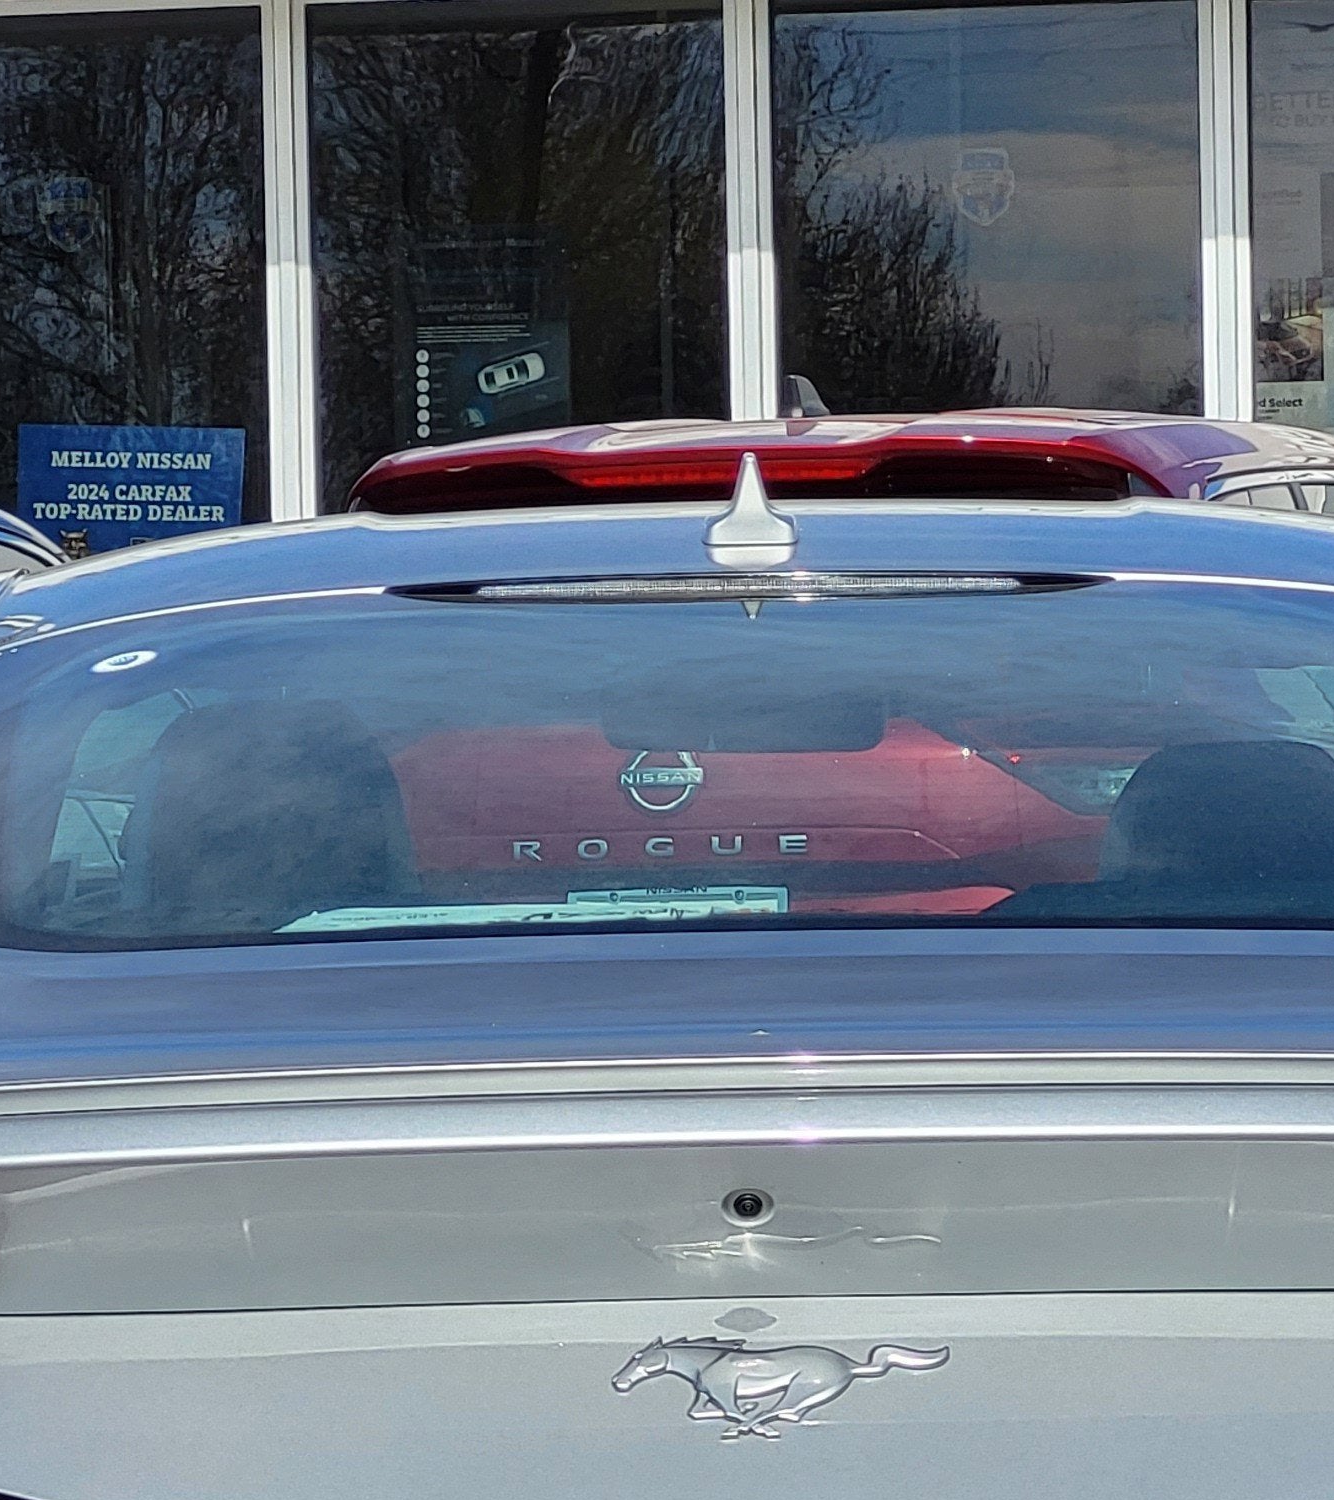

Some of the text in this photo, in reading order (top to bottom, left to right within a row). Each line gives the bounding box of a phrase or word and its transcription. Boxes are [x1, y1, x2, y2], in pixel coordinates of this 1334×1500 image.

[51, 450, 212, 470] MELLOY NISSAN
[67, 484, 192, 502] 2024 CARFAX
[33, 502, 225, 523] TOP-RATED DEALER
[620, 770, 701, 784] NISSAN
[512, 834, 809, 862] ROGUE
